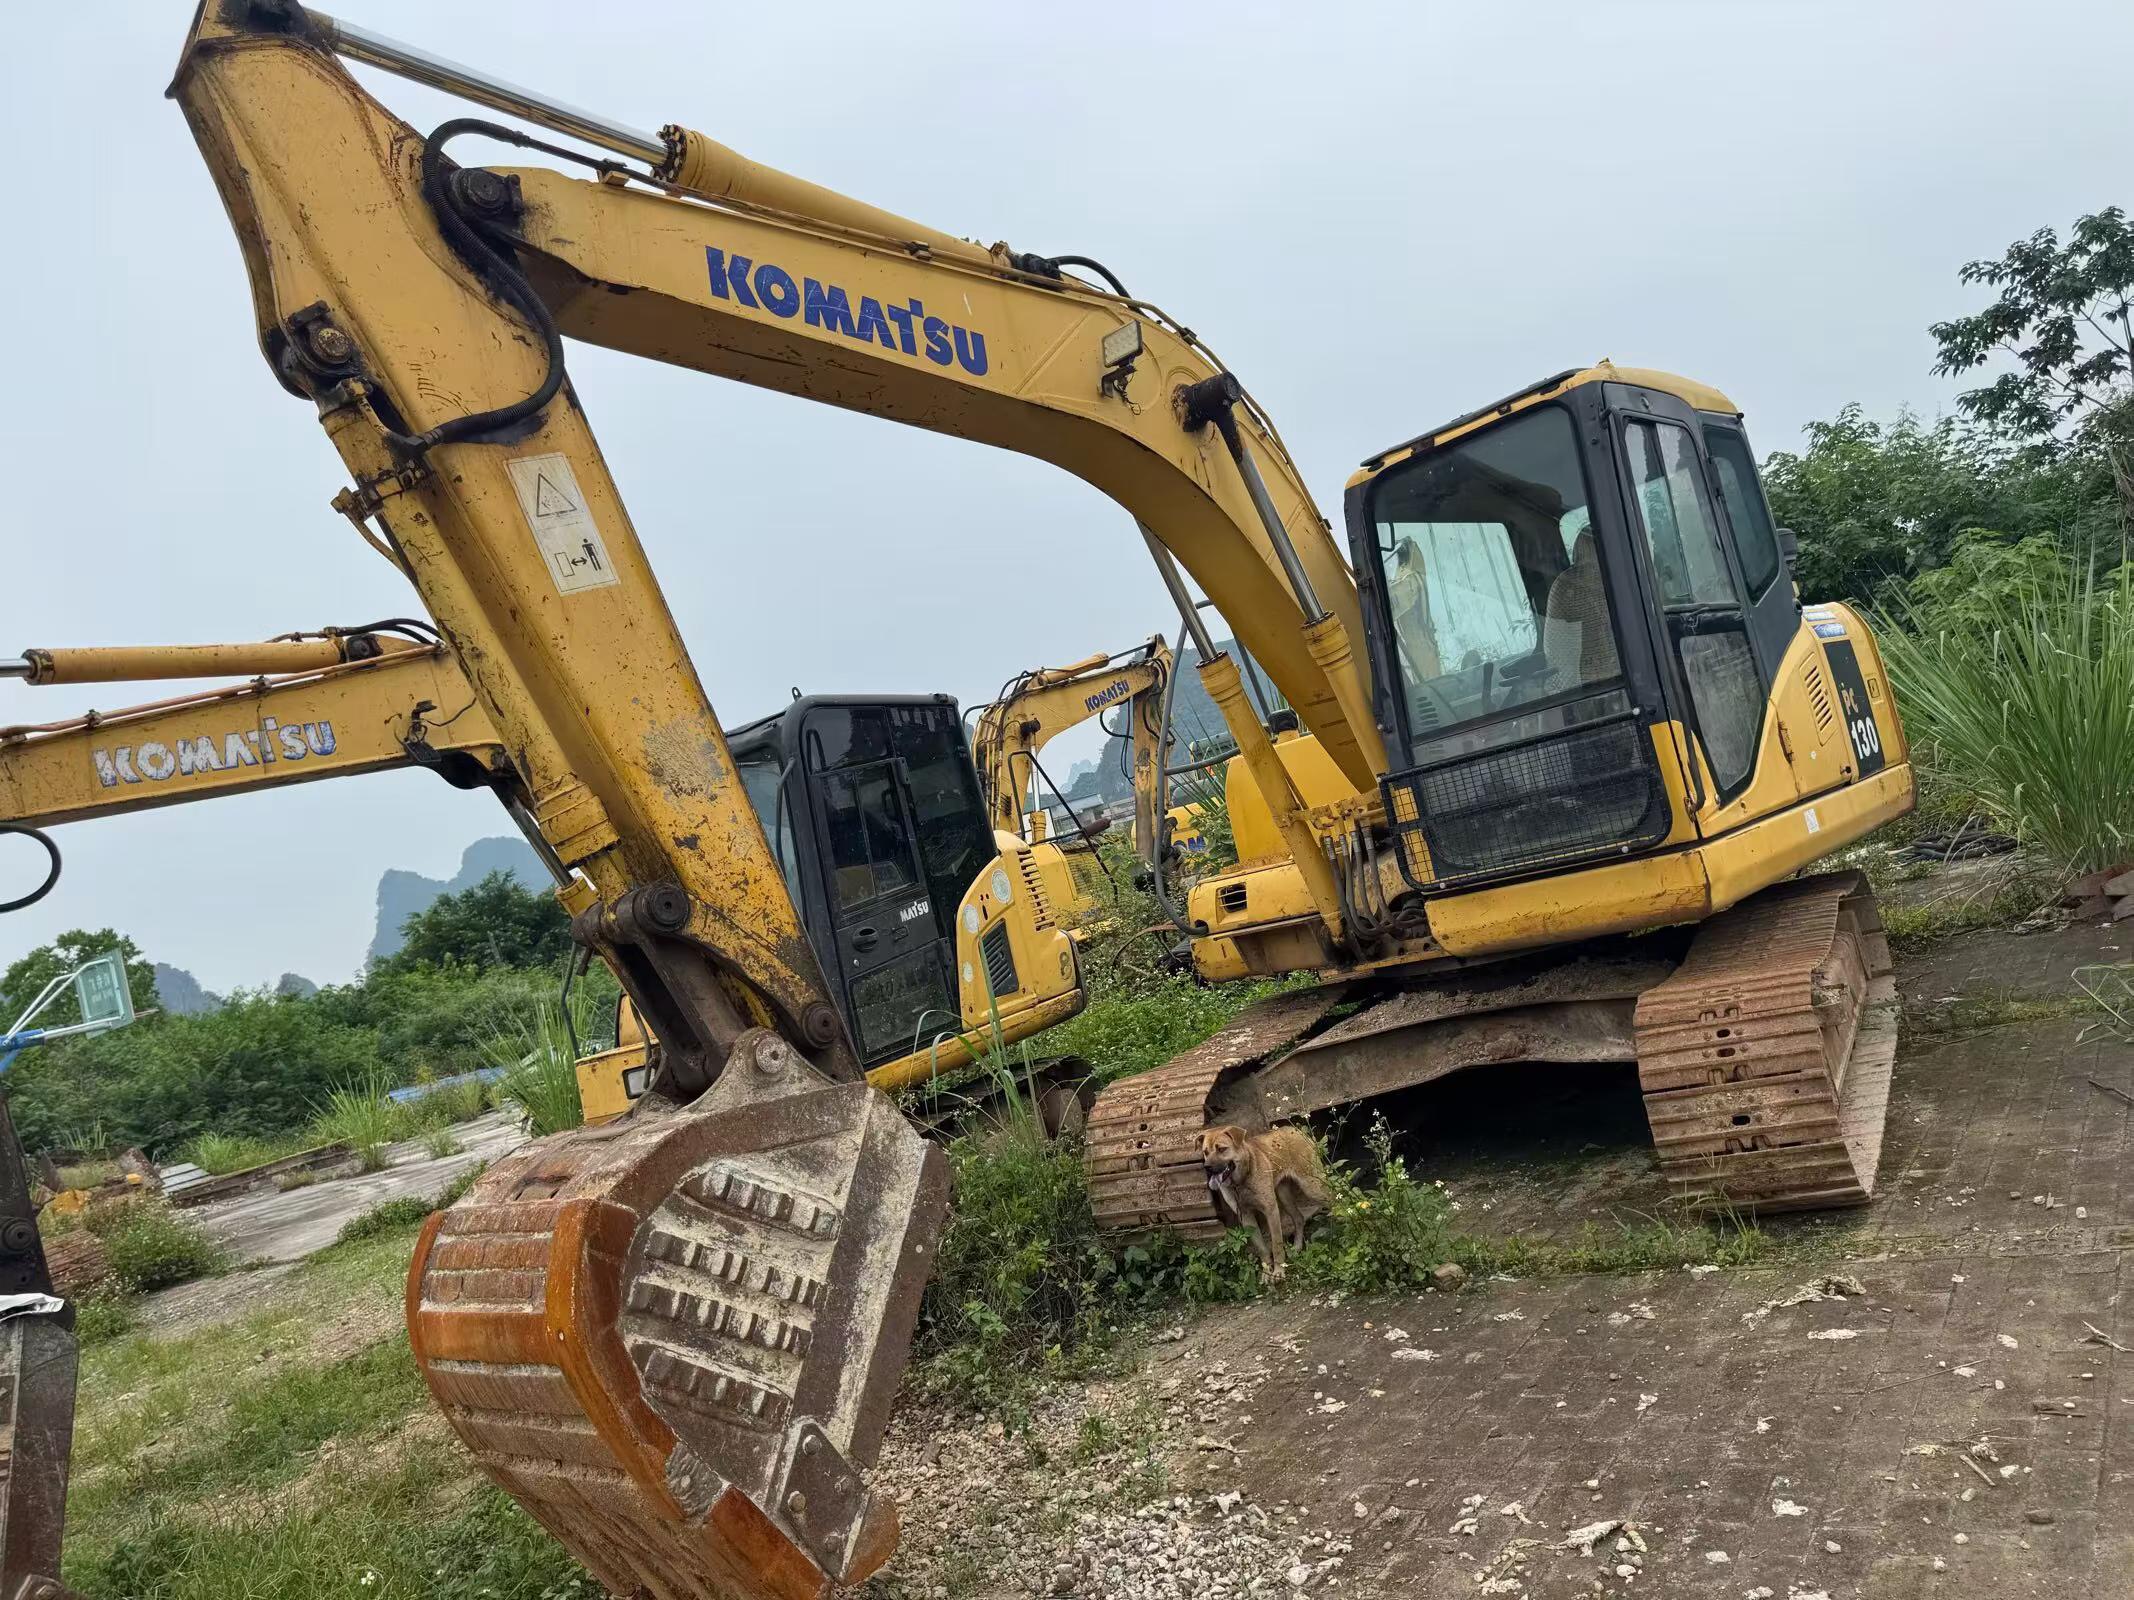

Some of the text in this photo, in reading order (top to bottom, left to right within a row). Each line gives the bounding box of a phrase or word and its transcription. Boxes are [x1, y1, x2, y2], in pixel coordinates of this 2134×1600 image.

[705, 245, 988, 376] KOMATSU
[1084, 680, 1130, 712] KOMATSU
[93, 716, 337, 788] KOMATSU
[1851, 716, 1879, 760] 130
[900, 901, 930, 923] MATSU
